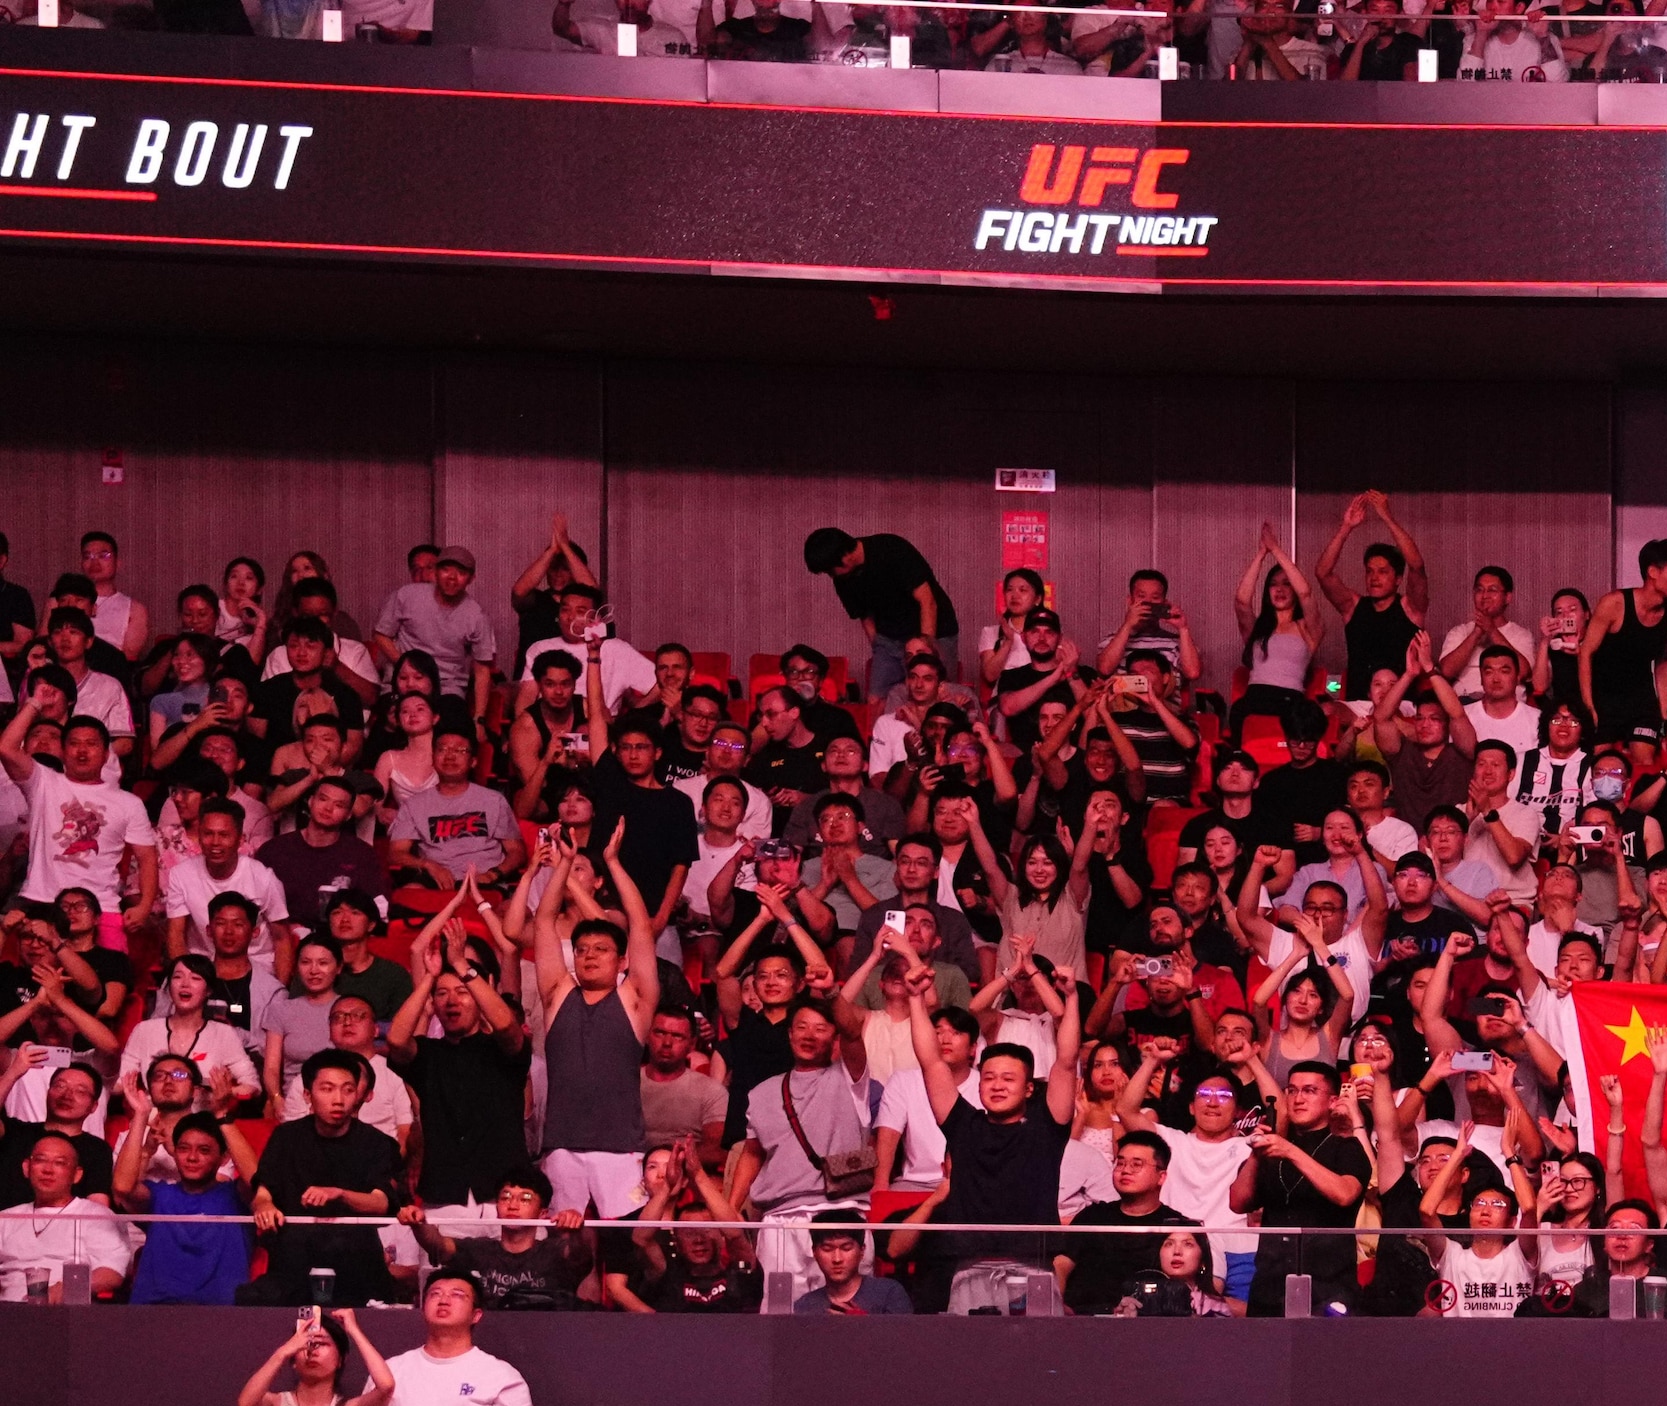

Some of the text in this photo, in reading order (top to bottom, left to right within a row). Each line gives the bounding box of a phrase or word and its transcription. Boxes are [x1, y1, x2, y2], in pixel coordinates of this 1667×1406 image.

[126, 119, 313, 190] BOUT
[1019, 144, 1190, 208] UFC
[974, 210, 1218, 255] FIGHT NIGHT
[435, 814, 481, 841] UFC
